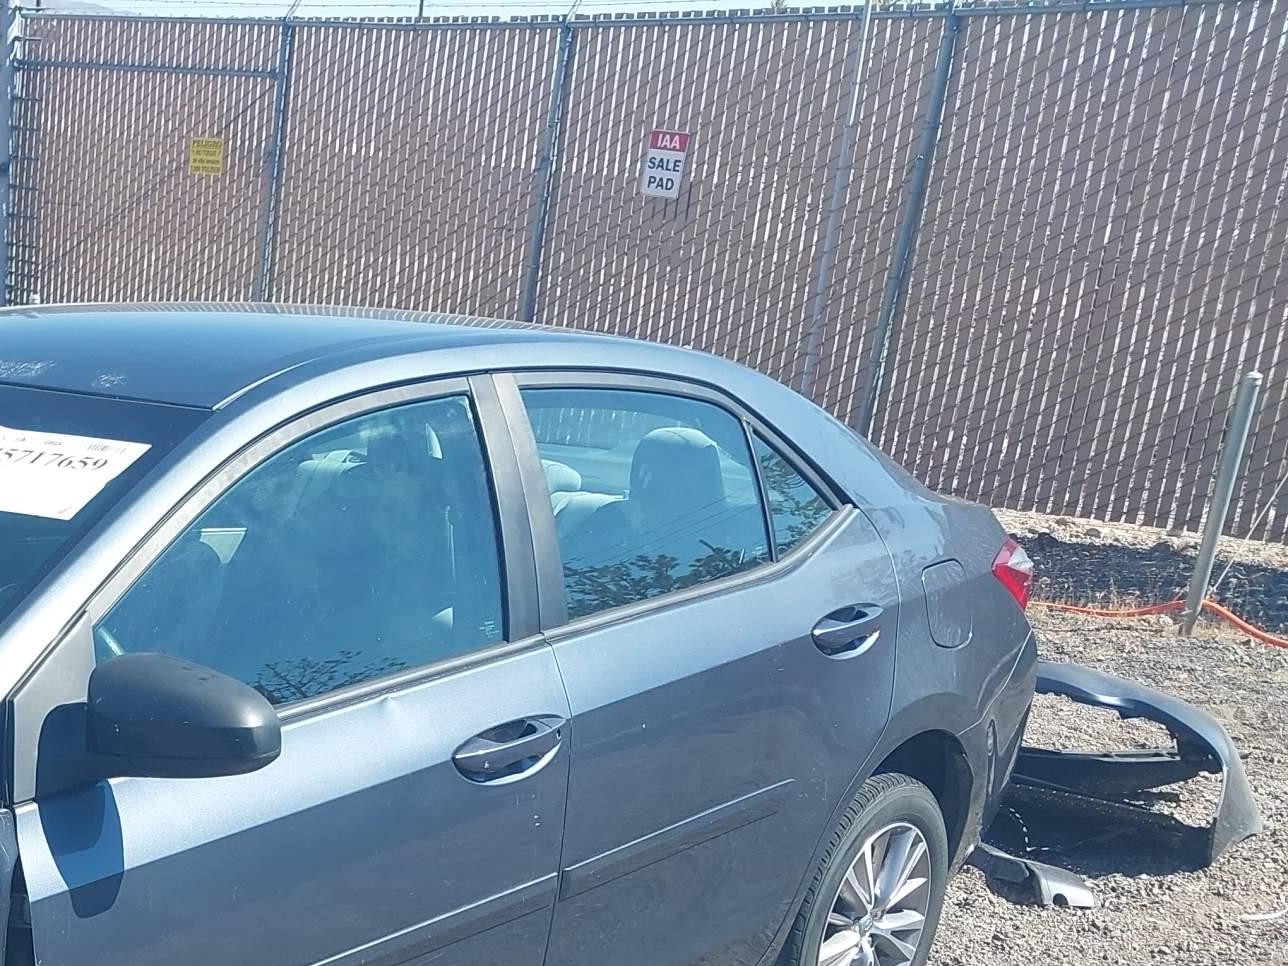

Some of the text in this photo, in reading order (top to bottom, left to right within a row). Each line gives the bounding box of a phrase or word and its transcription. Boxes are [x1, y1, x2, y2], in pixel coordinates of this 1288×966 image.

[657, 134, 680, 149] IAA
[647, 156, 682, 172] SALE
[647, 176, 674, 190] PAD
